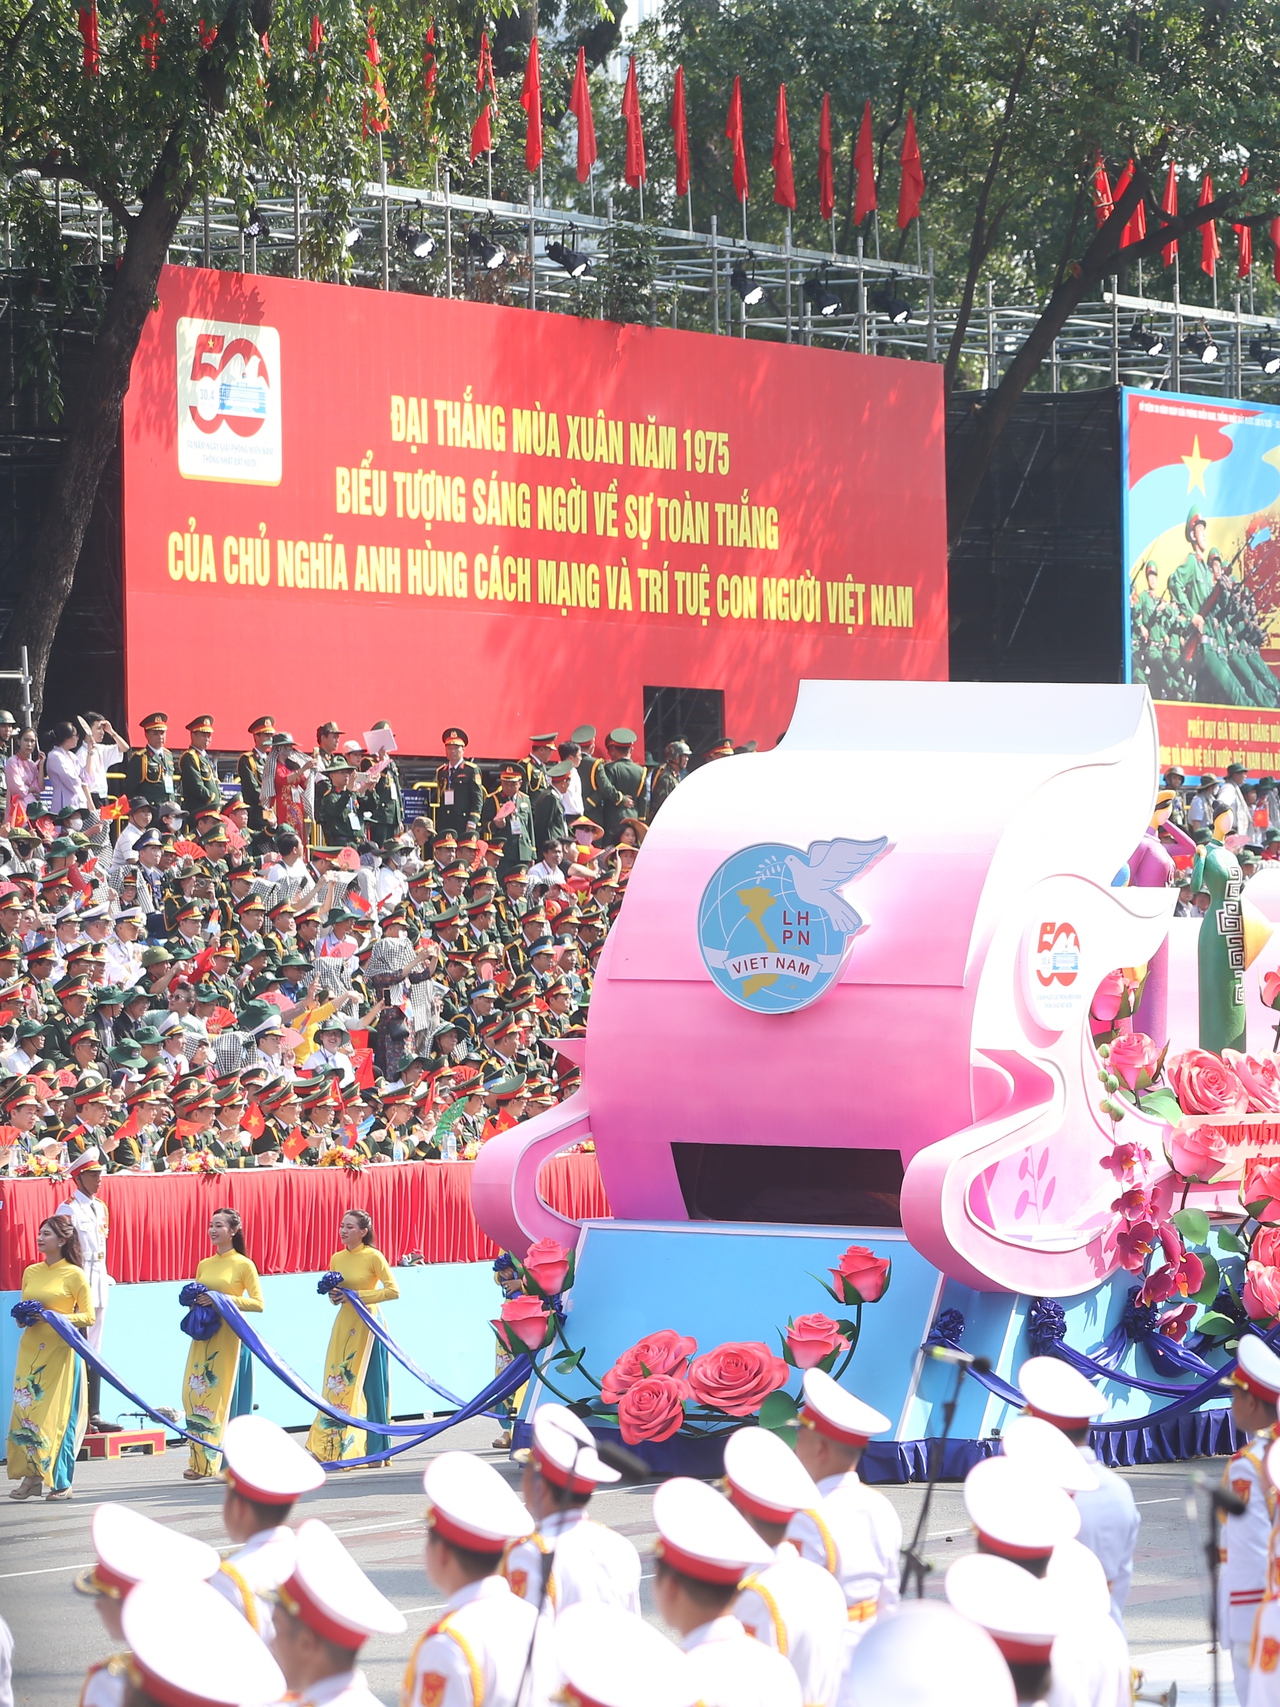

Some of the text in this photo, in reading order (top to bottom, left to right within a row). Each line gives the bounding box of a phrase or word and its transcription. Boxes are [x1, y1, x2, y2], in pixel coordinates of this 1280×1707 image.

[390, 385, 730, 475] ĐẠI THẮNG MÙA XUÂN NĂM 1975
[336, 450, 779, 550] BIỂU TƯỢNG SÁNG NGỜI VỀ SỰ TOÀN THẮNG
[168, 516, 913, 634] CỦA CHỦ NGHĨA ANH HÙNG CÁCH MẠNG VÀ TRÍ TUỆ CON NGƯỜI VIỆT NAM
[732, 957, 810, 976] VIET NAM
